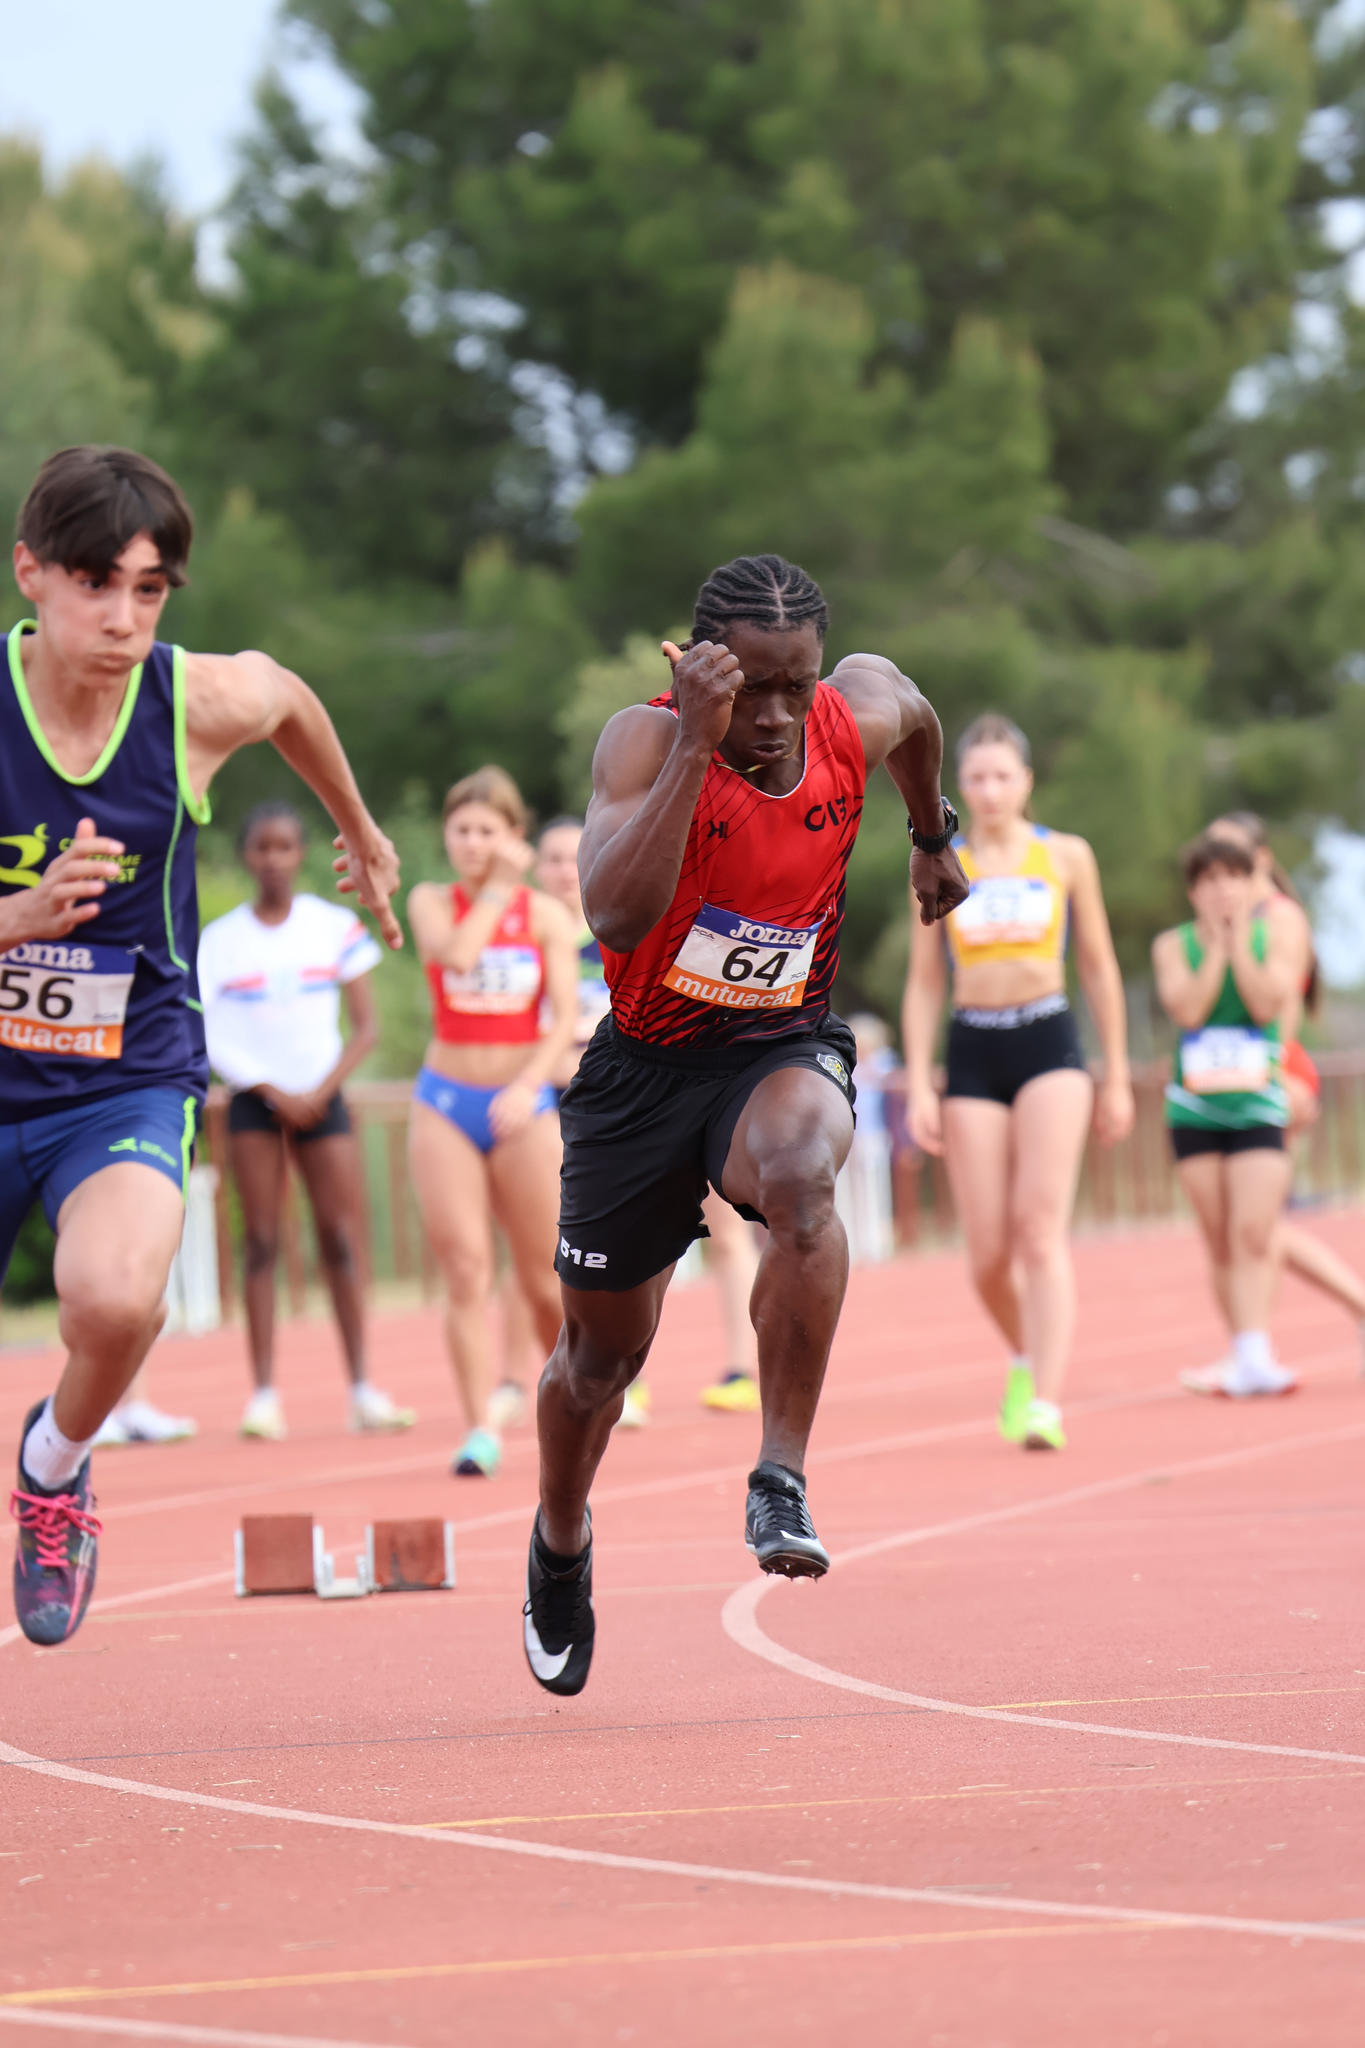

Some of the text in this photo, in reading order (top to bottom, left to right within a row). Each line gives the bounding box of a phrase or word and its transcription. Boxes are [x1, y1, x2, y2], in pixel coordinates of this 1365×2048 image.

[729, 919, 809, 947] Joma
[0, 943, 95, 971] oma
[721, 946, 790, 988] 64
[0, 969, 75, 1020] 56
[674, 974, 796, 1007] mutuacat
